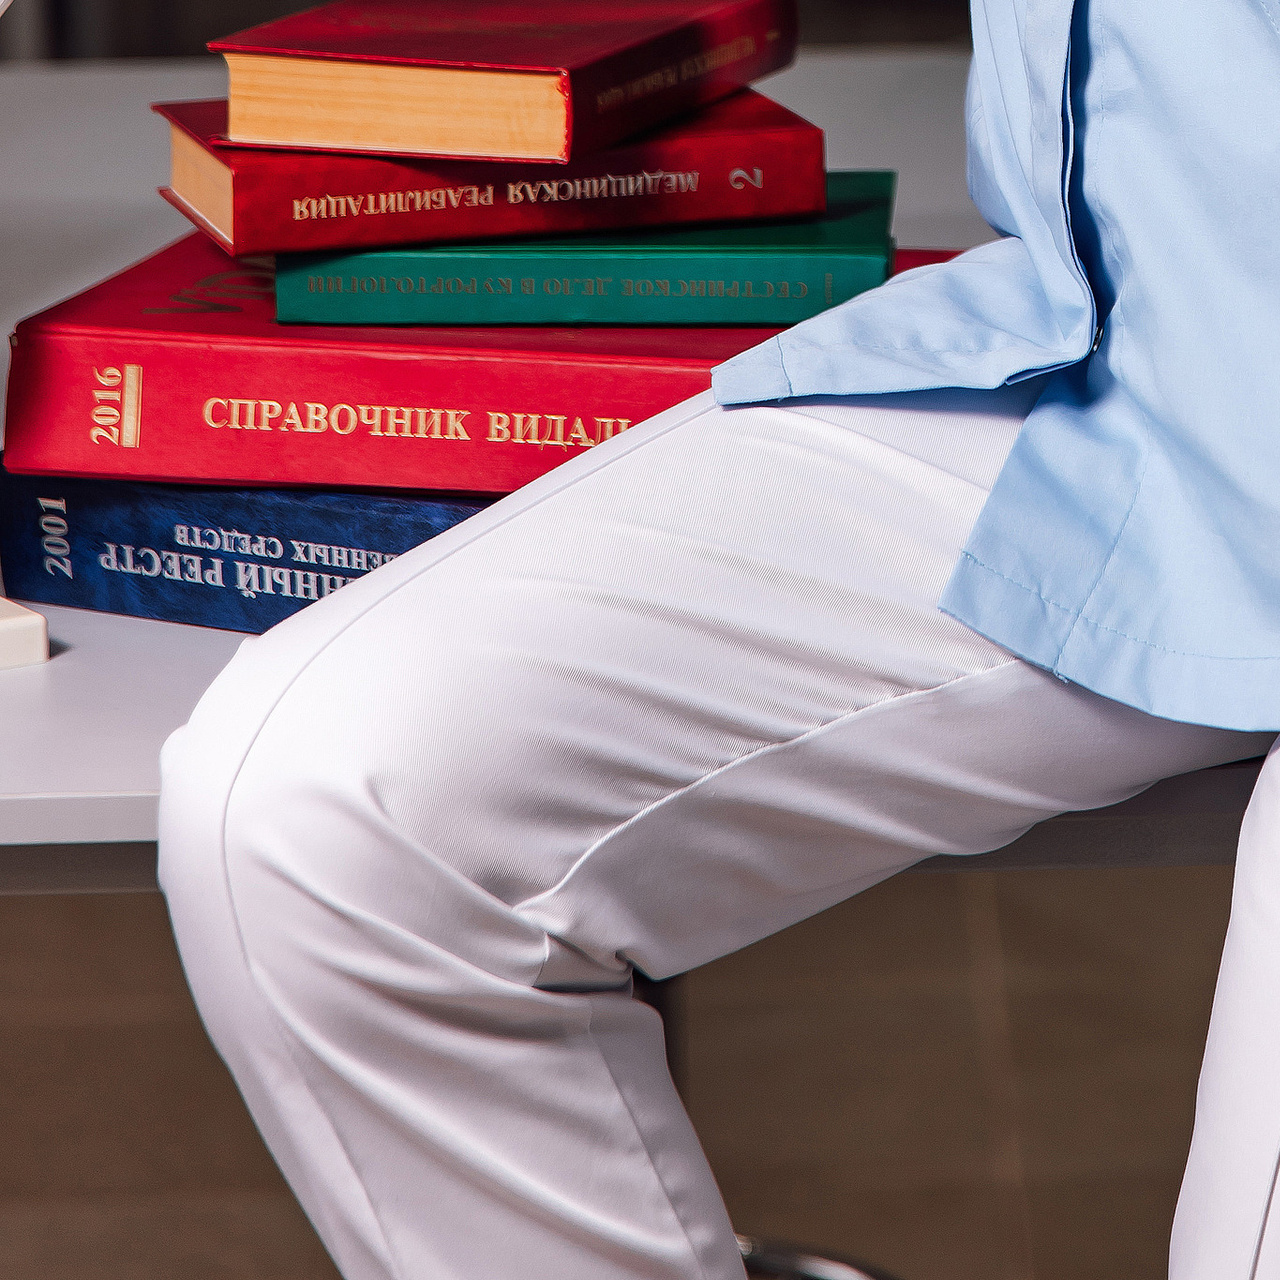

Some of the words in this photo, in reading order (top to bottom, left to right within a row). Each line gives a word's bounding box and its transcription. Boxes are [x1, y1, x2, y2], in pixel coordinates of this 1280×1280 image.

[507, 169, 700, 205] МЕДИЦИНСКАЯ
[728, 166, 764, 190] 2
[292, 184, 495, 221] РЕАБИЛИТАЦИЯ
[307, 275, 513, 295] КУРОРТОЛОГИИ
[520, 277, 536, 296] В
[543, 276, 613, 297] ДЕЛО
[620, 277, 809, 299] СЕСТРИНСКОЕ
[89, 365, 123, 447] 2016
[202, 396, 472, 441] СПРАВОЧНИК
[36, 496, 74, 580] 2001
[173, 523, 284, 560] СРЕДСТВ
[98, 541, 226, 589] РЕЕСТР
[233, 560, 357, 600] ННЫЙ
